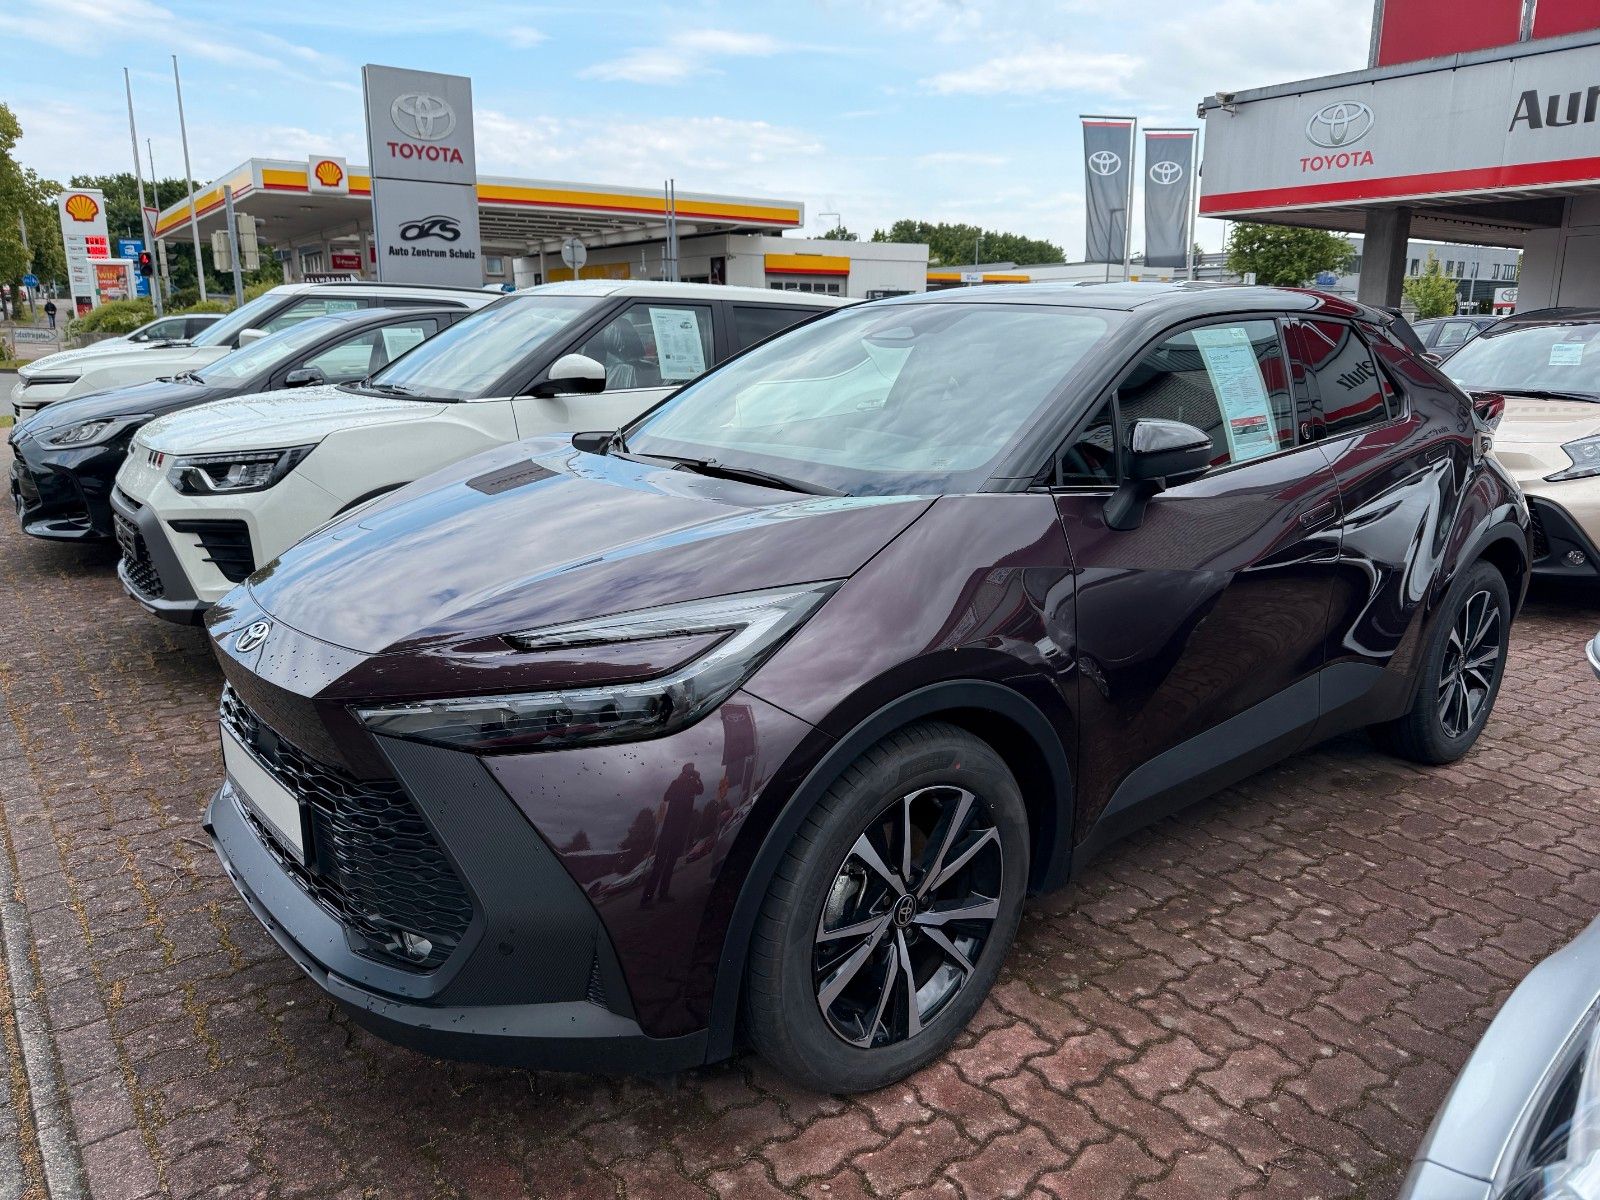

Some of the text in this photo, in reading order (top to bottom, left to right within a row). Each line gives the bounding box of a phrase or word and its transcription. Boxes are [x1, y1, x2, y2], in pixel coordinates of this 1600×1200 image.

[387, 142, 464, 165] TOYOTA
[1300, 150, 1375, 173] TOYOTA
[388, 245, 476, 260] Auto Zentrum Schulz
